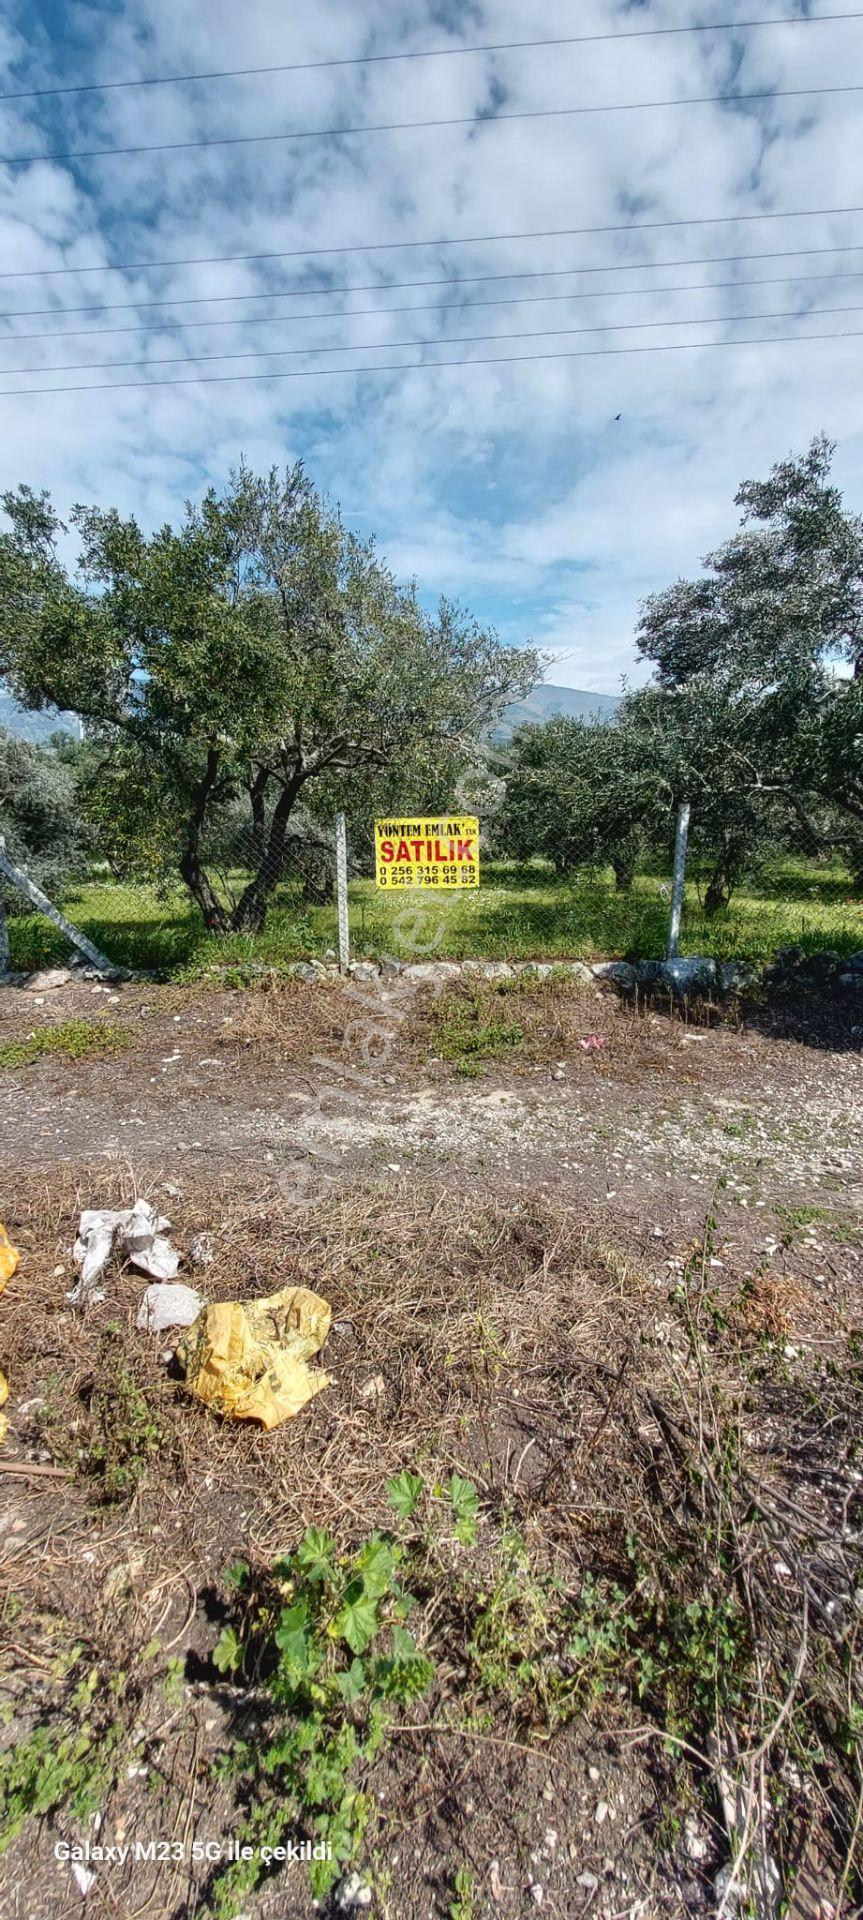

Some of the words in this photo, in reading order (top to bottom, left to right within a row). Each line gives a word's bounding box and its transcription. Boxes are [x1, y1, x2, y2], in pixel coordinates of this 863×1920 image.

[377, 823, 421, 837] YÖNTEM
[380, 840, 474, 862] SATILIK
[380, 866, 387, 875] 0
[391, 866, 413, 875] 256
[417, 865, 439, 875] 315
[443, 865, 457, 874] 69
[461, 865, 475, 874] 68
[380, 876, 387, 885] 0
[391, 876, 413, 885] 542
[417, 875, 439, 884] 796
[443, 875, 457, 884] 45
[461, 875, 475, 884] 82
